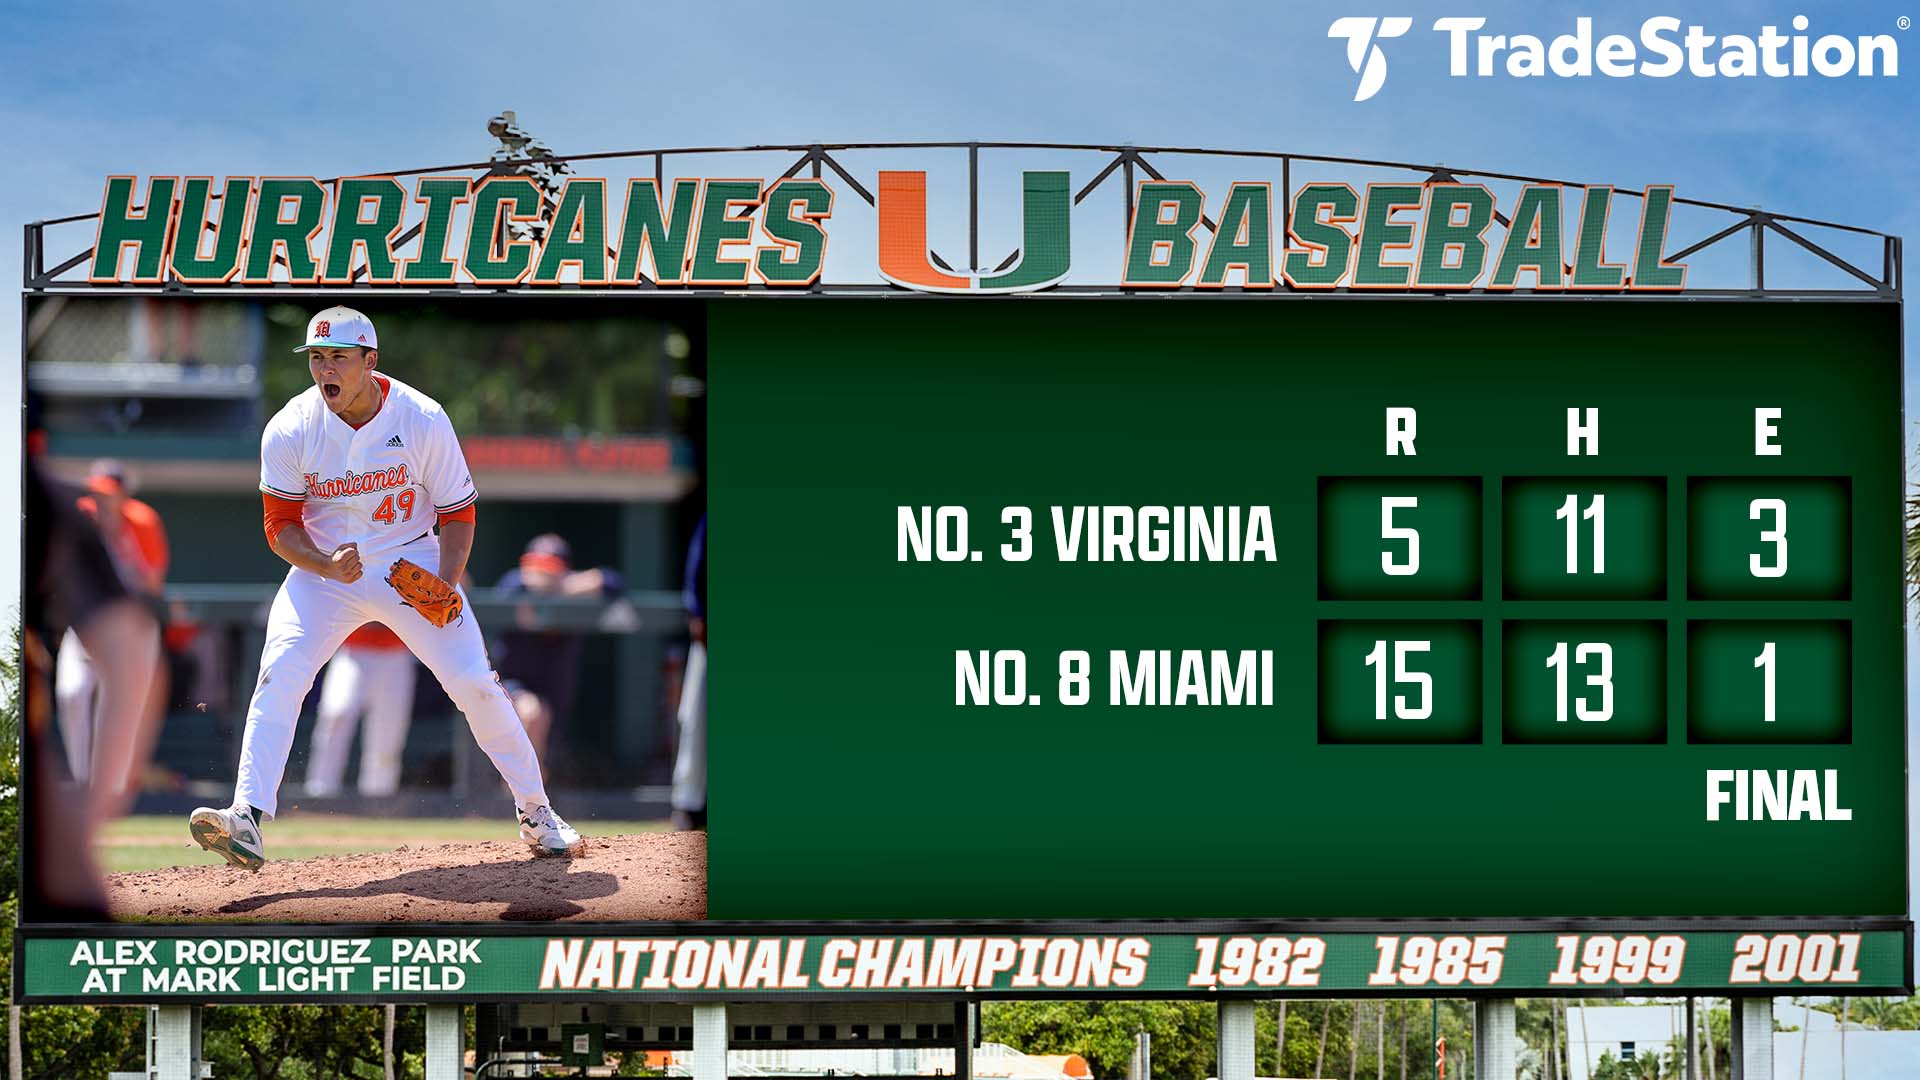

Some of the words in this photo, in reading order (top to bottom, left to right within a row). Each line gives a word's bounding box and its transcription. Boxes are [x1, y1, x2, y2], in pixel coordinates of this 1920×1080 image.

[88, 175, 836, 286] HURRICANES
[877, 171, 1071, 293] U
[1120, 180, 1688, 293] BASEBALL
[1386, 407, 1417, 456] R
[1567, 407, 1599, 456] H
[1755, 407, 1782, 456] E
[304, 463, 408, 500] Hurricanes
[372, 488, 416, 525] 49
[897, 505, 983, 562] NO.
[1000, 506, 1033, 562] 3
[1050, 505, 1278, 562] VIRGINIA
[1381, 496, 1420, 576] 5
[1556, 494, 1605, 574] 11
[1749, 498, 1788, 578] 3
[955, 649, 1041, 706] NO.
[1058, 650, 1091, 706] 8
[1109, 649, 1274, 706] MIAMI
[1365, 640, 1433, 720] 15
[1546, 642, 1614, 722] 13
[1754, 642, 1776, 722] 1
[1706, 769, 1853, 821] FINAL
[69, 940, 158, 966] ALEX
[175, 938, 371, 965] RODRIGUEZ
[392, 938, 482, 964] PARK
[538, 938, 810, 989] NATIONAL
[817, 938, 1151, 988] CHAMPIONS
[1188, 936, 1326, 987] 1982
[1367, 936, 1505, 986] 1985
[1549, 935, 1687, 985] 1999
[1730, 934, 1862, 984] 2001
[81, 967, 127, 993] AT
[142, 967, 241, 993] MARK
[258, 966, 354, 992] LIGHT
[372, 966, 466, 992] FIELD
